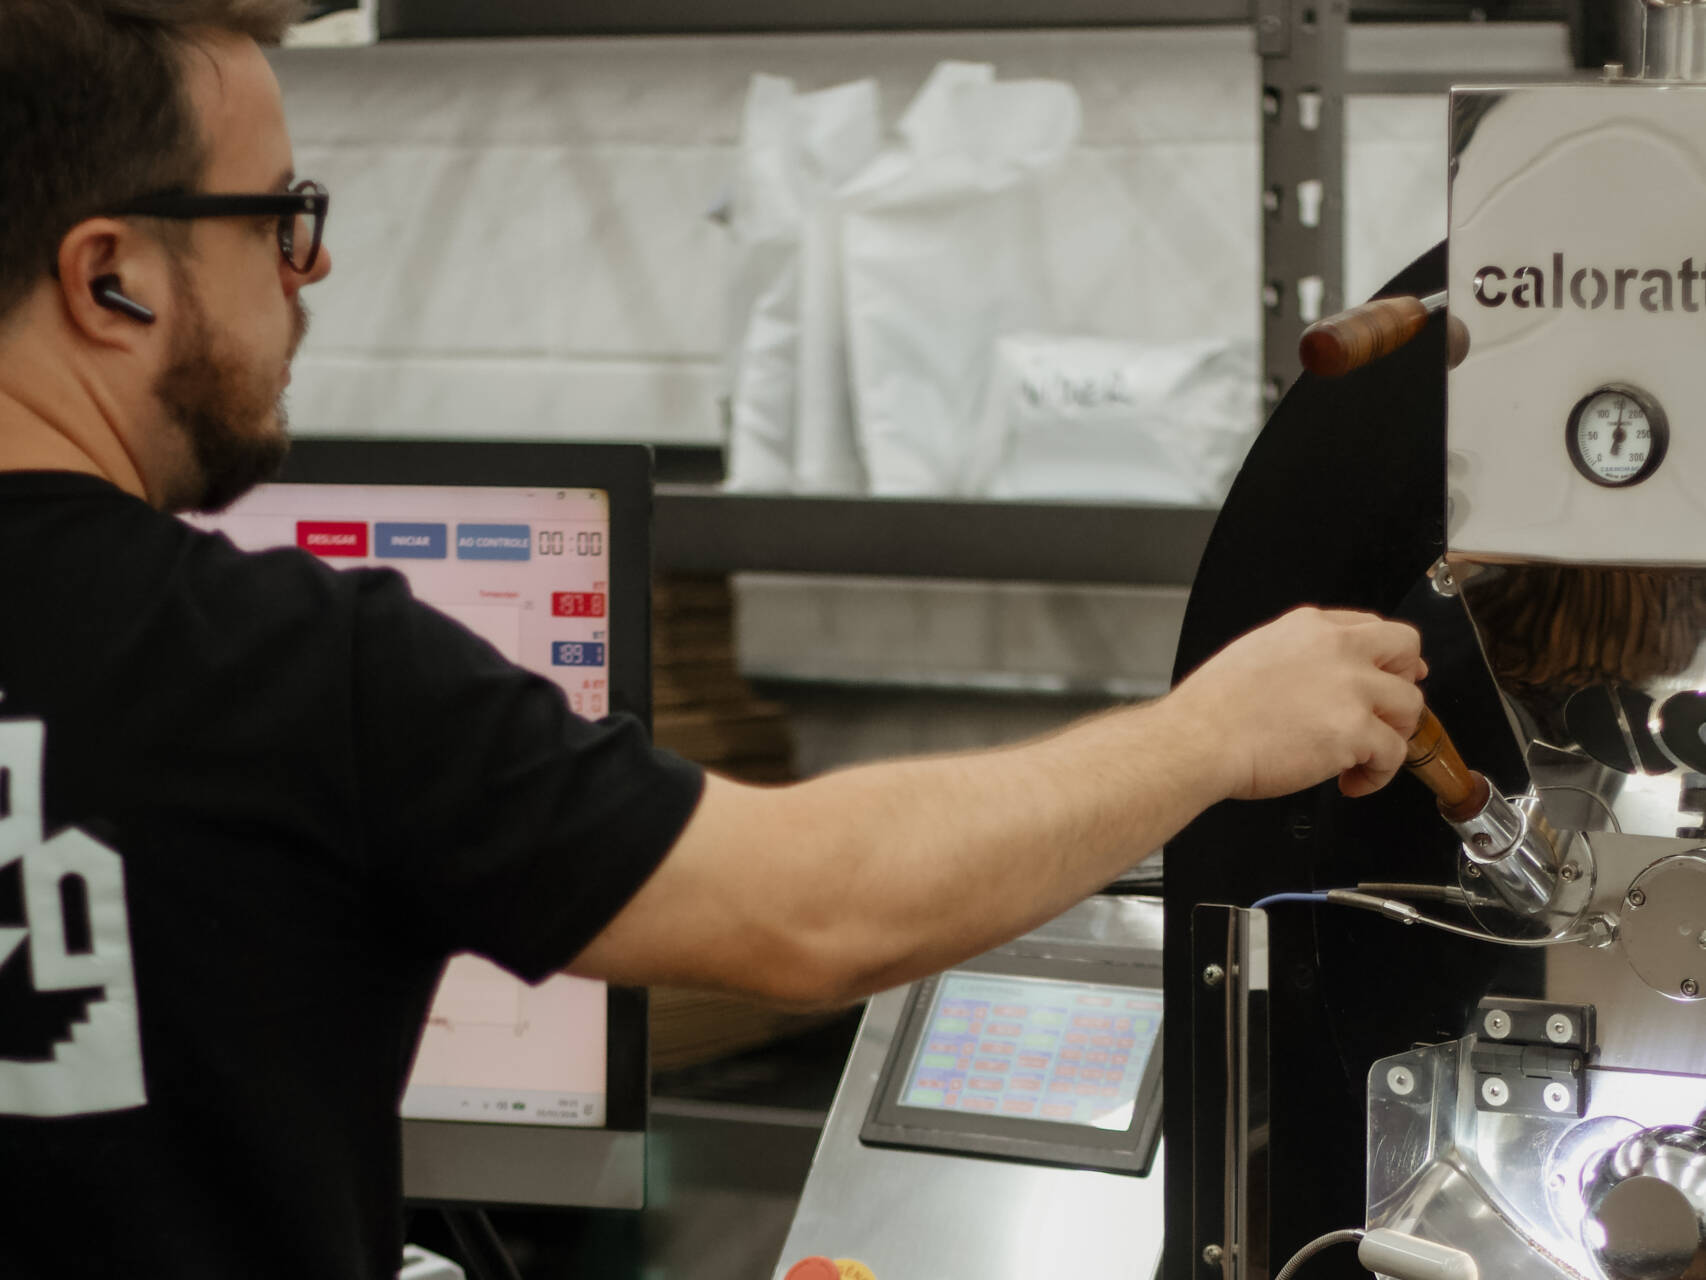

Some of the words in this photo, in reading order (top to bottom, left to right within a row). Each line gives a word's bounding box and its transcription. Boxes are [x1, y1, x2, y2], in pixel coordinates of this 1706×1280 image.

[1473, 252, 1706, 312] calorat
[1597, 409, 1609, 418] 100
[1628, 410, 1644, 419] 200
[1588, 431, 1598, 440] 50
[1636, 430, 1651, 439] 250
[1629, 453, 1644, 462] 300
